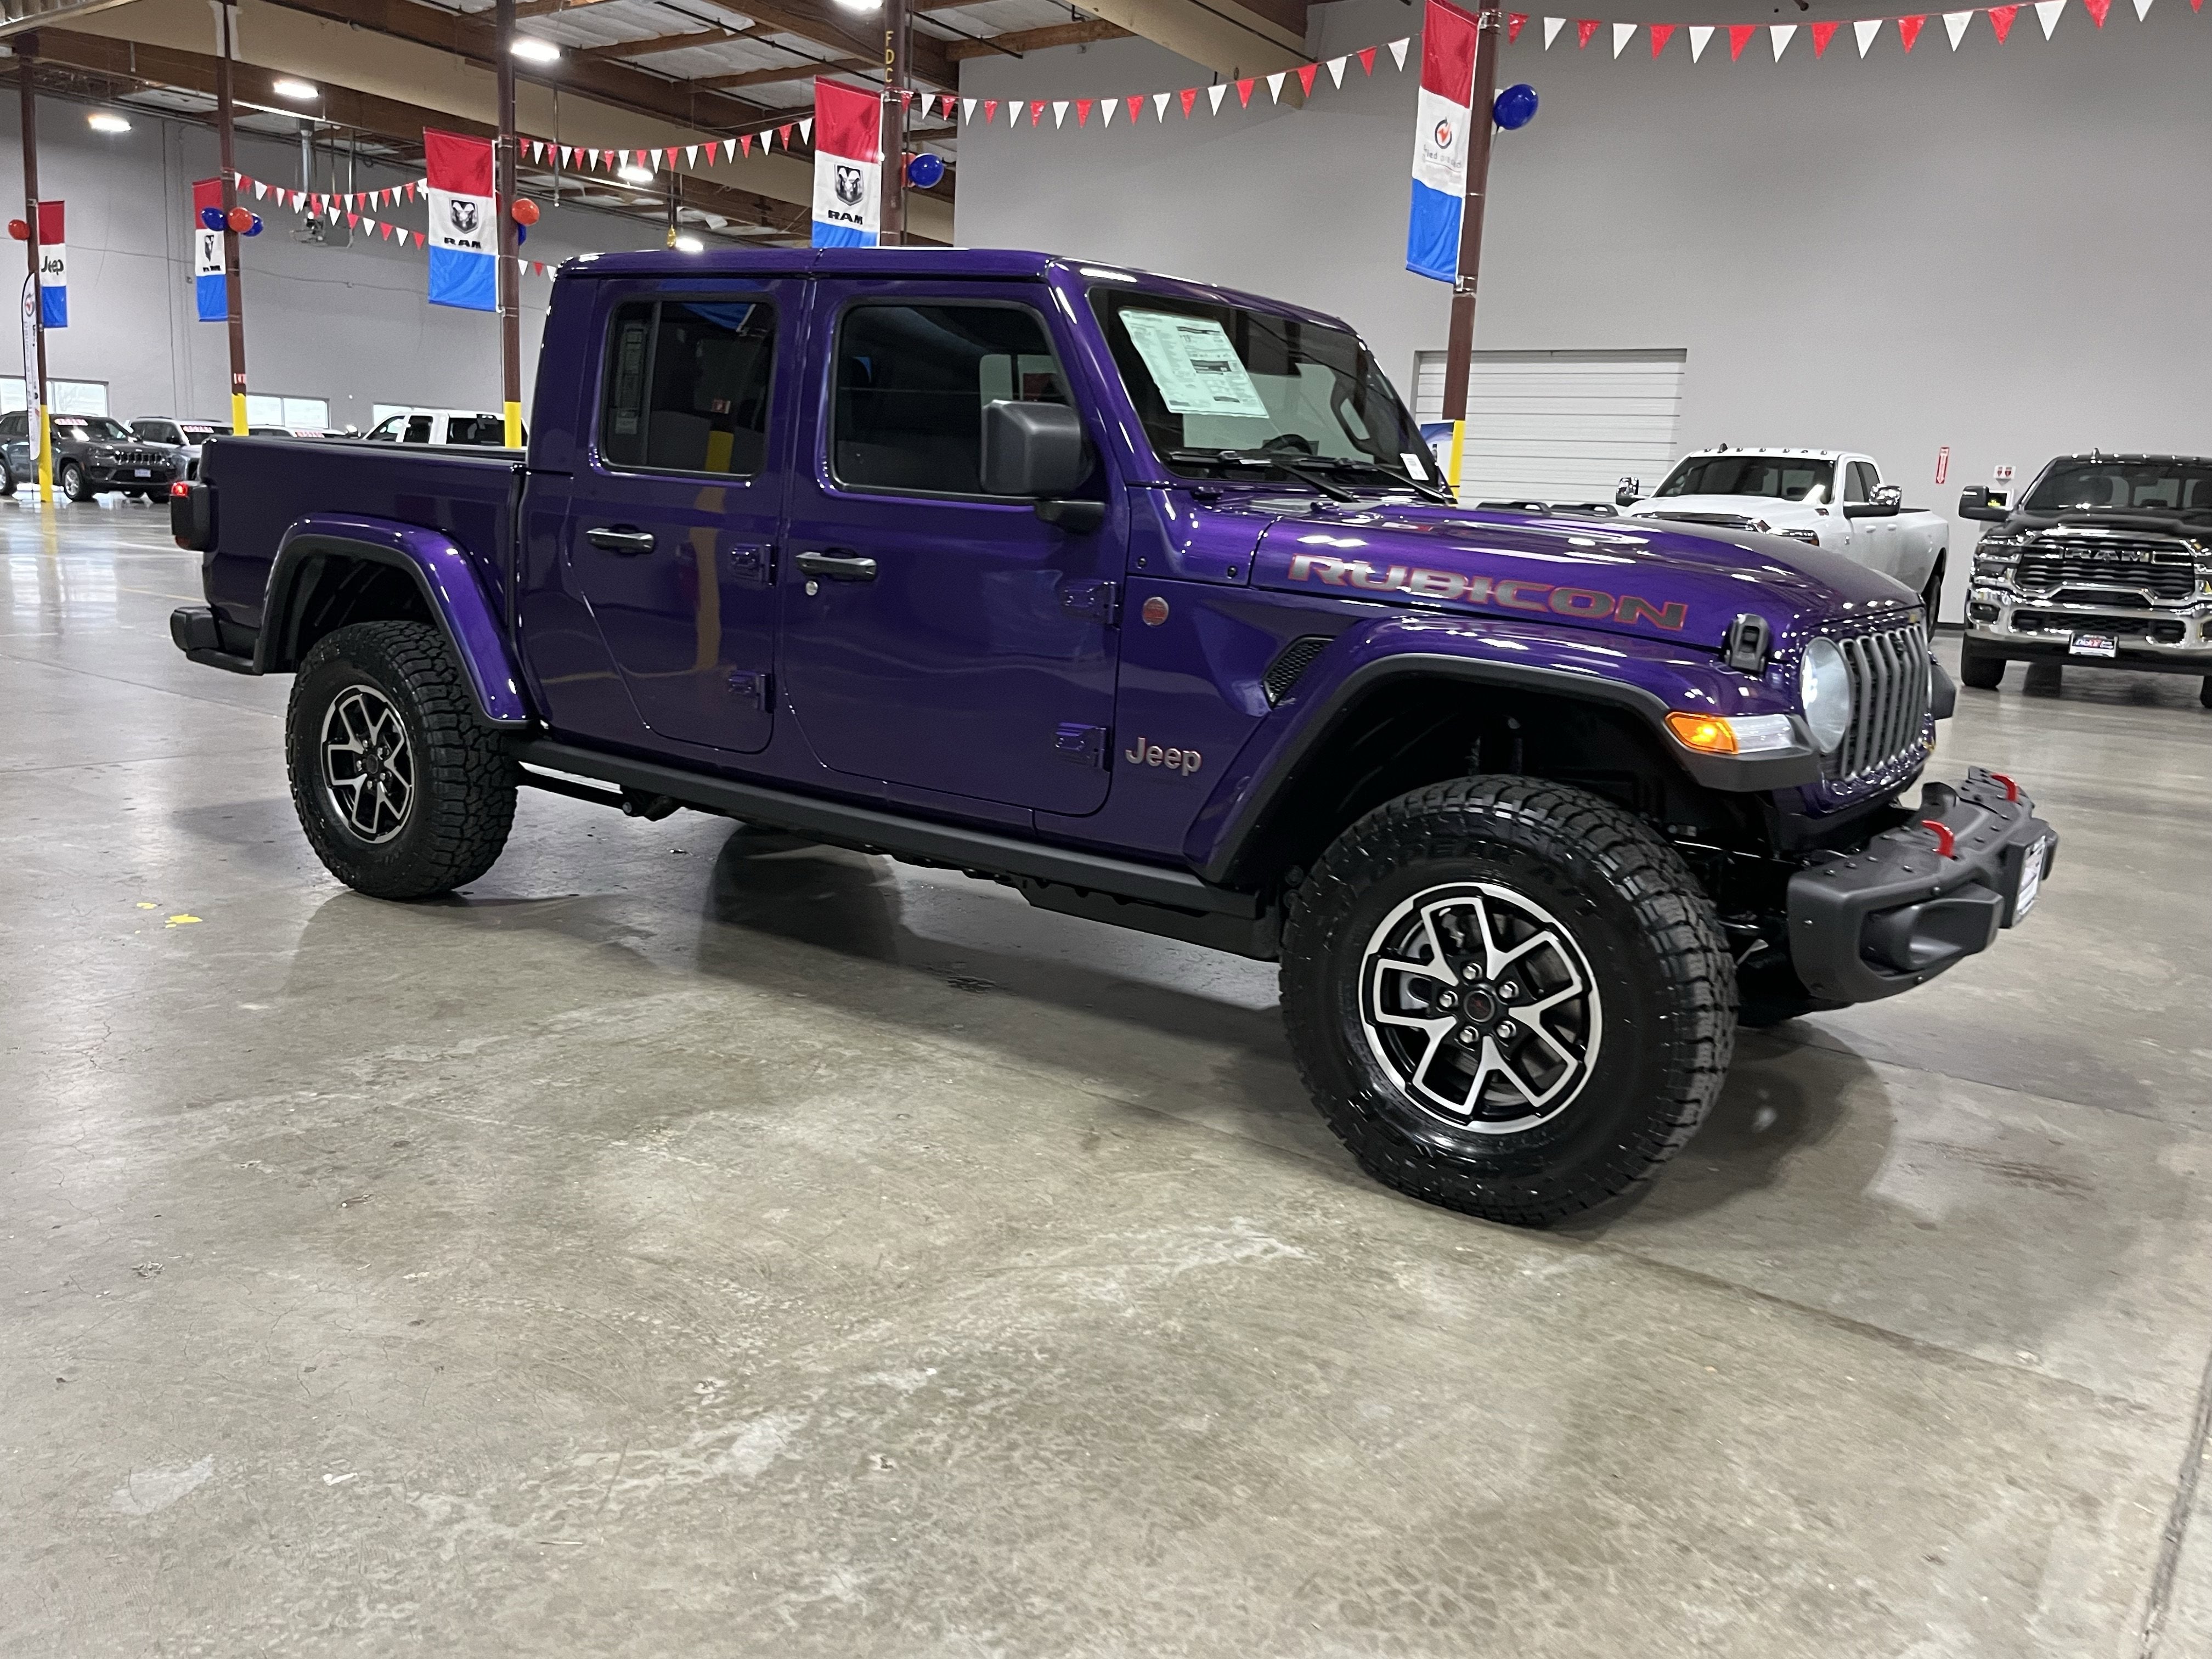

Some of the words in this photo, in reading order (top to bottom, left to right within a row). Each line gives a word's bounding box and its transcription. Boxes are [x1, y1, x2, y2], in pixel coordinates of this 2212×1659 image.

[885, 31, 894, 82] FDC
[828, 210, 863, 225] RAM
[444, 237, 482, 249] RAM
[2064, 548, 2149, 562] RAM
[1288, 553, 1688, 630] RUBICON
[1125, 737, 1201, 777] Jeep
